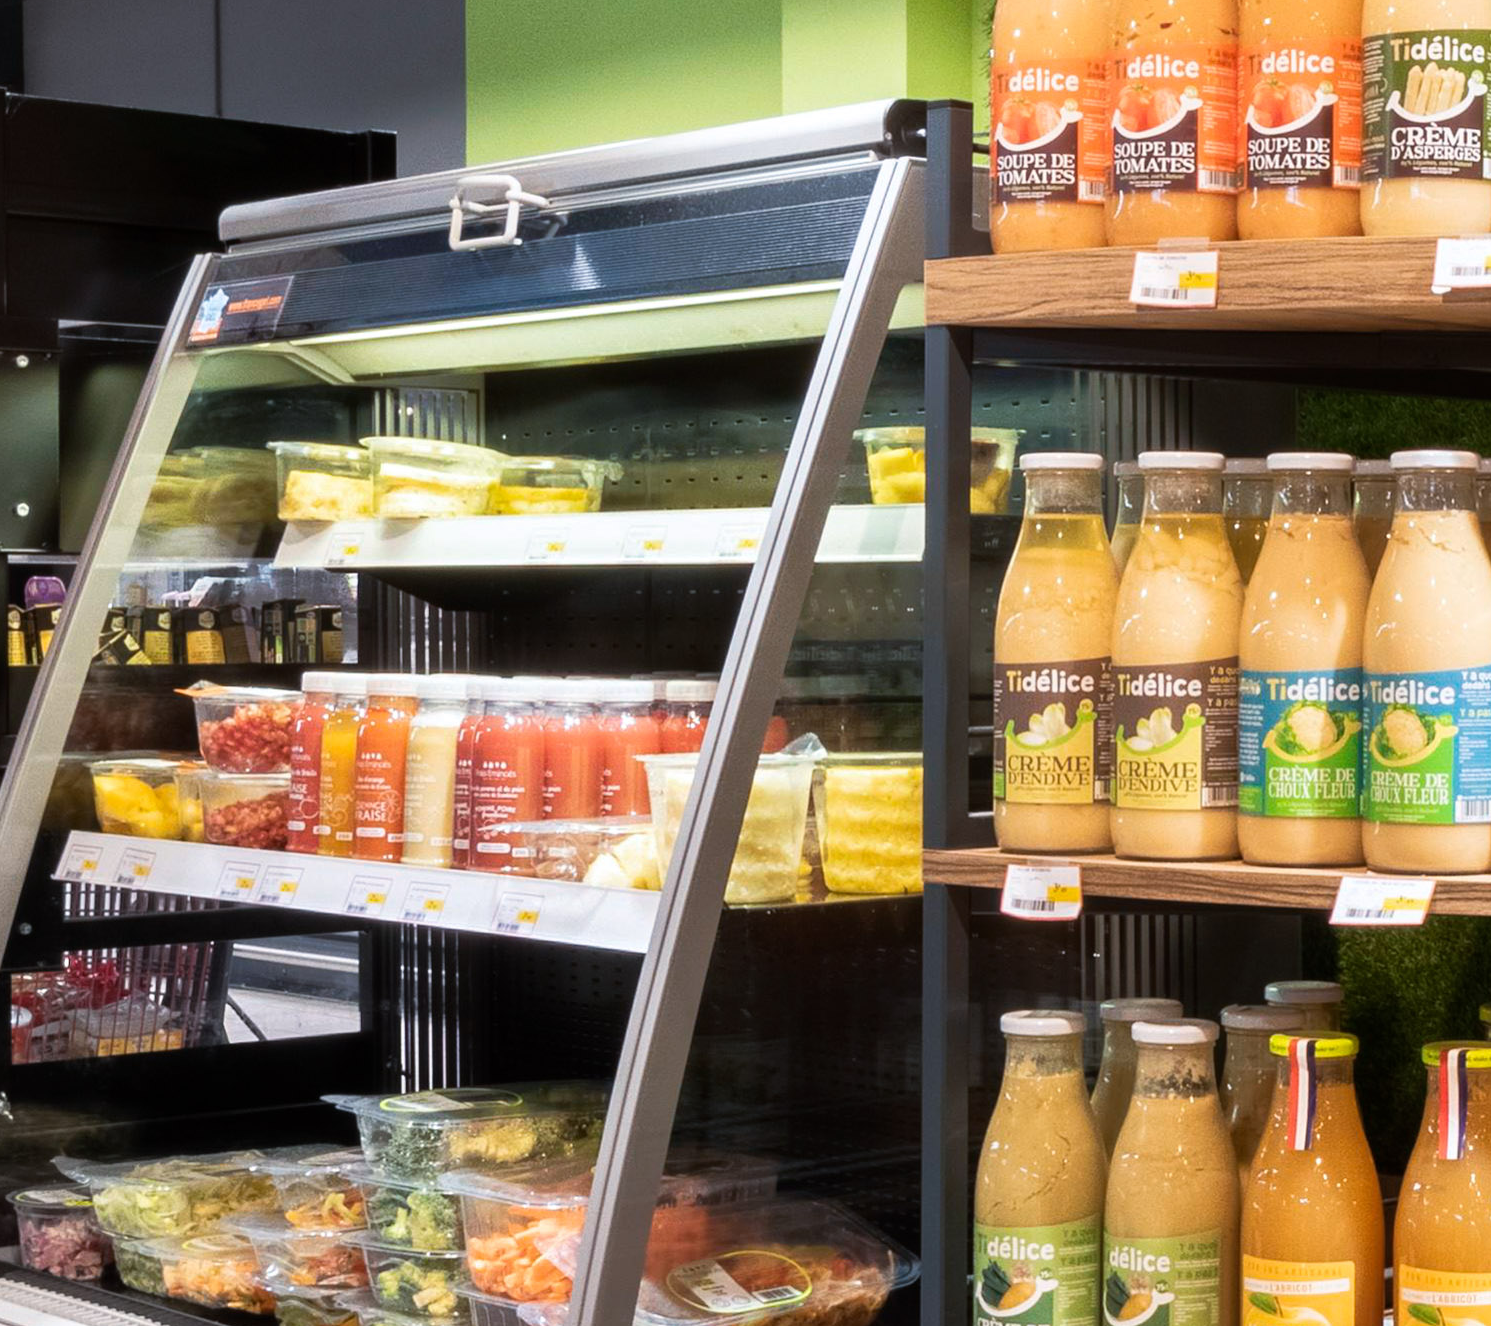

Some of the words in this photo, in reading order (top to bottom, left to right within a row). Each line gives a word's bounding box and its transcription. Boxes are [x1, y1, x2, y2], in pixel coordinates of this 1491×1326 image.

[1390, 35, 1485, 64] Tidélice
[1391, 124, 1481, 147] CRÈME
[1114, 141, 1168, 159] SOUPE
[1171, 142, 1195, 157] DE
[1248, 138, 1300, 155] SOUPE
[1306, 138, 1330, 153] DE
[1391, 146, 1481, 162] D'ASPERGES
[997, 154, 1048, 170] SOUPE
[1051, 153, 1075, 168] DE
[1114, 158, 1195, 174] TOMATES
[1248, 153, 1330, 170] TOMATES
[998, 169, 1075, 185] TOMATES
[1007, 668, 1094, 693] Tidélice
[1118, 672, 1202, 698] Tidélice
[1266, 677, 1360, 701] Tidélice
[1008, 752, 1090, 773] CRÈME
[1119, 758, 1197, 779] CRÈME
[1008, 773, 1090, 786] D'ENDIVE
[1269, 765, 1333, 783] CRÈME
[1337, 767, 1355, 782] DE
[1426, 773, 1449, 789] DE
[1119, 778, 1197, 793] D'ENDIVE
[1268, 782, 1311, 799] CHOUX
[1315, 782, 1356, 799] FLEUR
[1408, 787, 1449, 805] FLEUR
